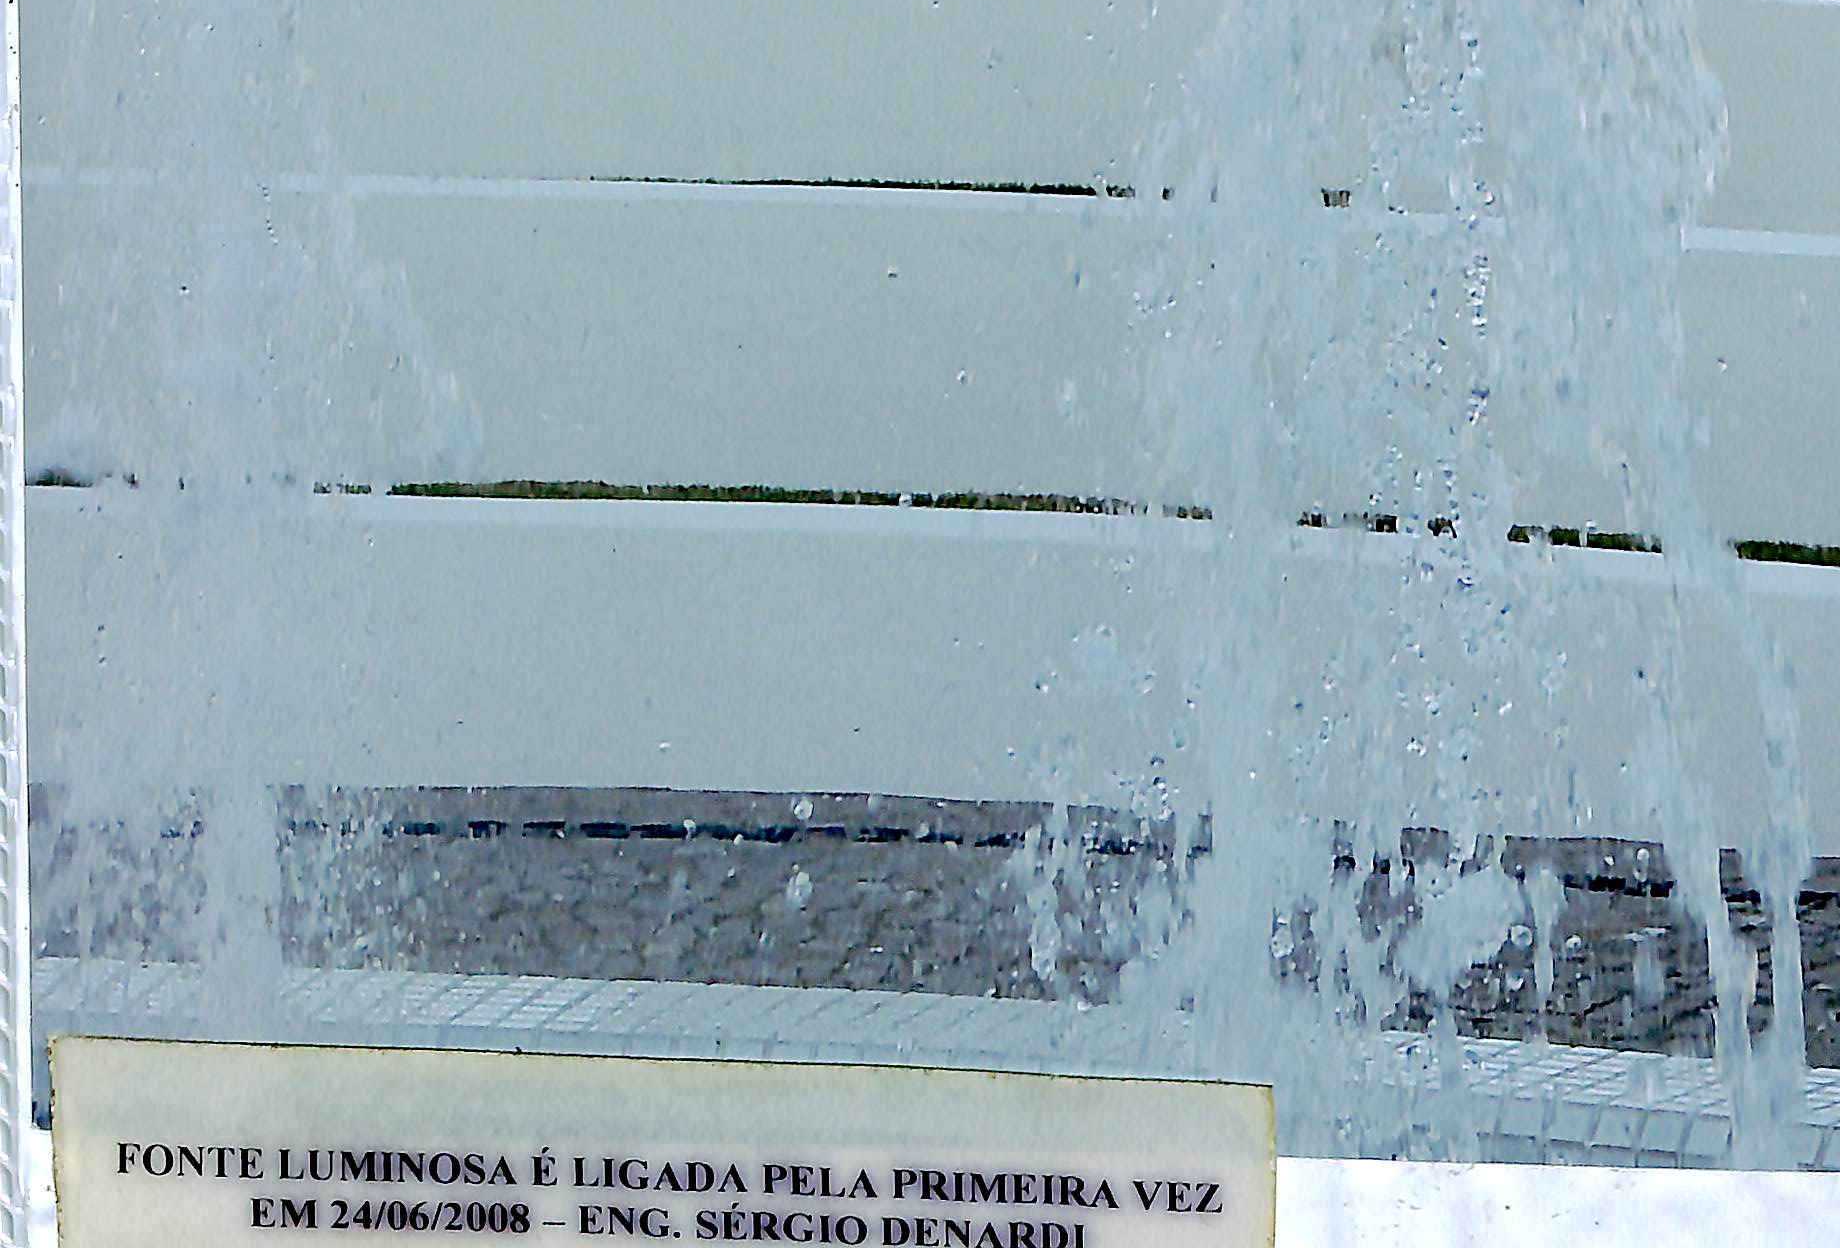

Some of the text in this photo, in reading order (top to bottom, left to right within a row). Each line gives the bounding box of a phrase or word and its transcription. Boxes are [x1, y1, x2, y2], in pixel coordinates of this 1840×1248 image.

[116, 1141, 1224, 1214] FONTE LUMINOSA É LIGADA PELA PRIMEIRA VEZ
[250, 1197, 319, 1229] EM
[330, 1199, 531, 1234] 24/06/2008
[578, 1204, 683, 1240] ENG.
[695, 1201, 869, 1246] SÉRGIO
[880, 1216, 1086, 1248] DENARDI
